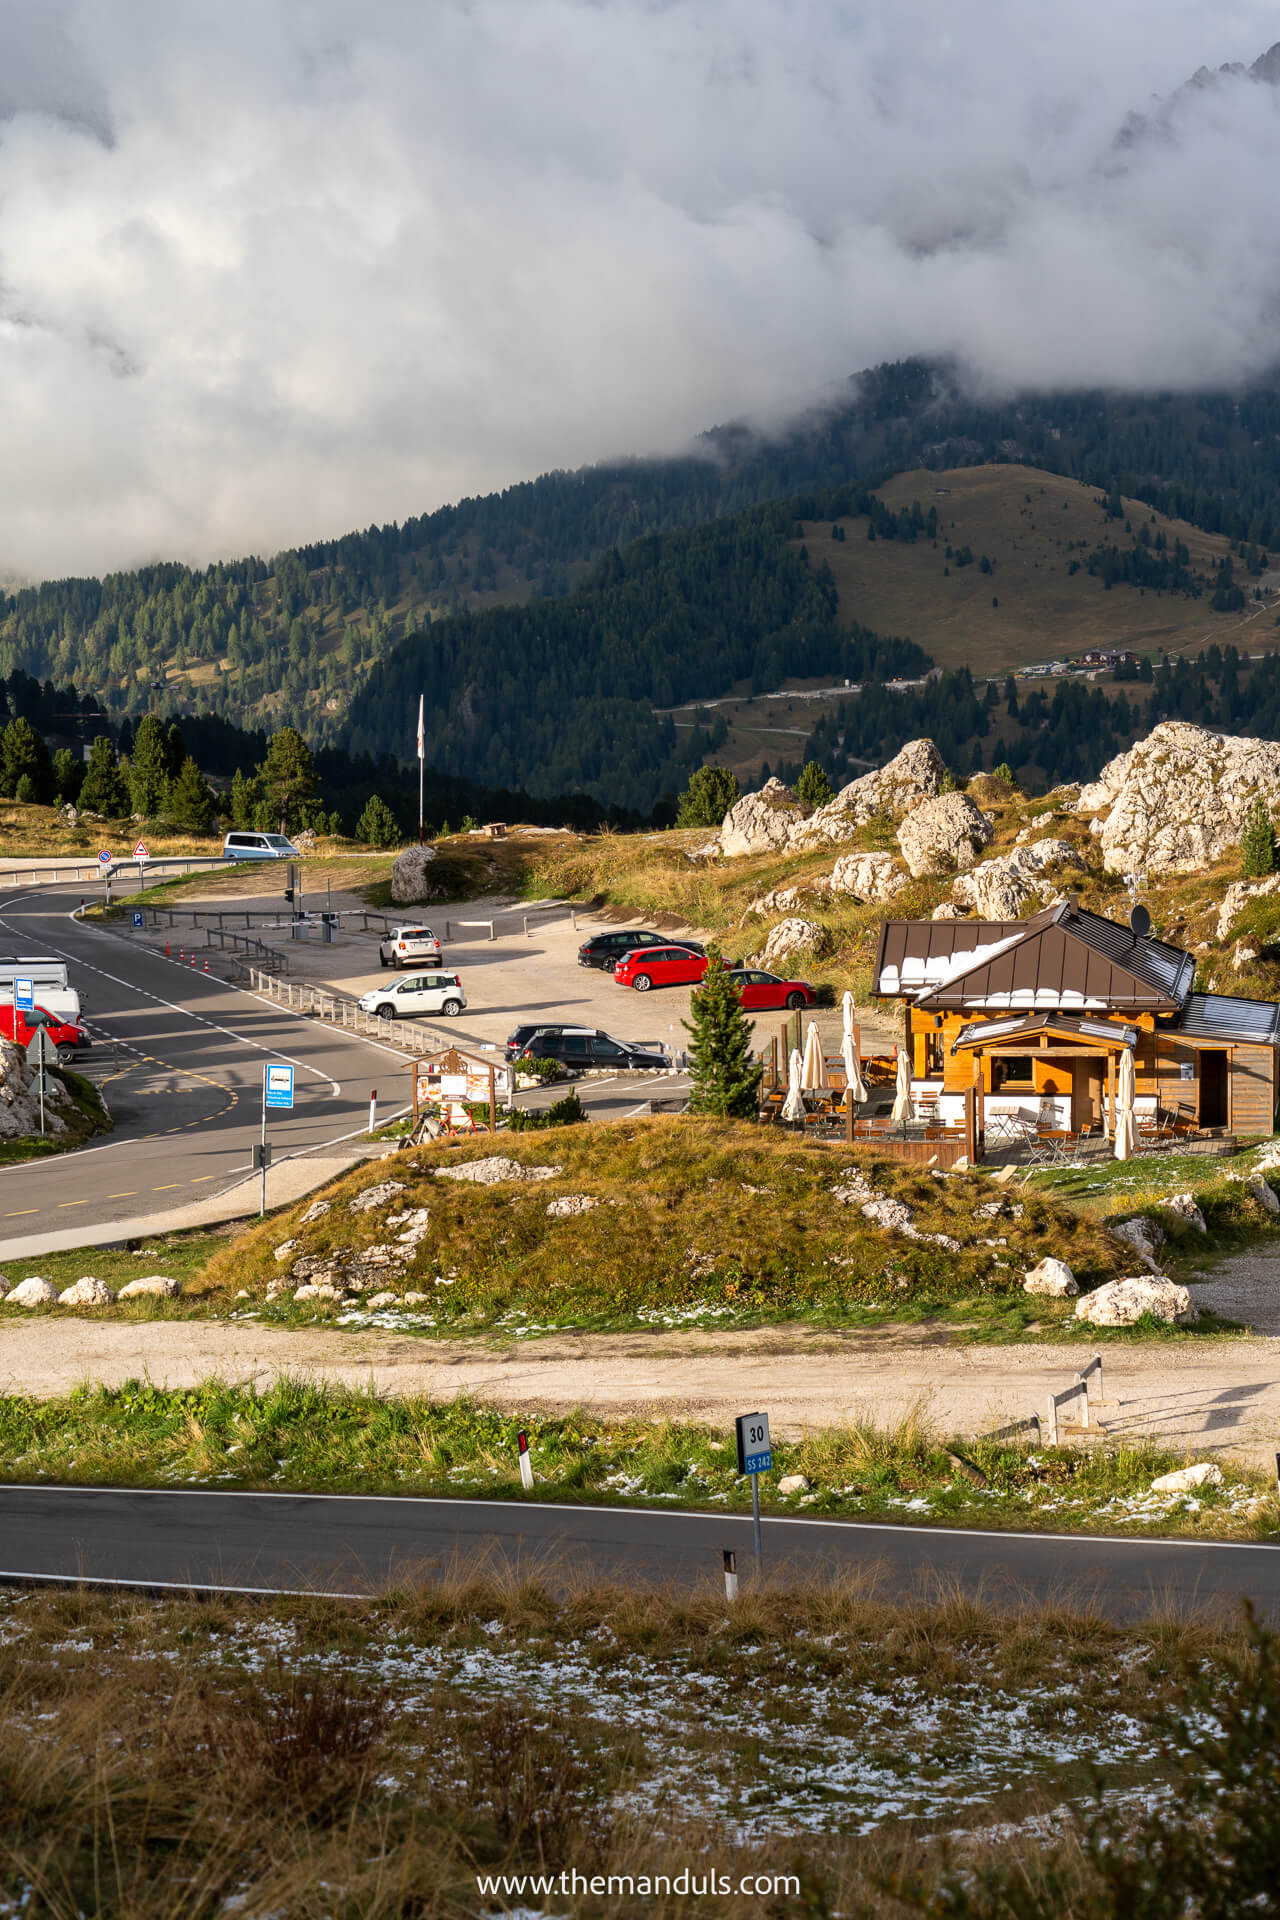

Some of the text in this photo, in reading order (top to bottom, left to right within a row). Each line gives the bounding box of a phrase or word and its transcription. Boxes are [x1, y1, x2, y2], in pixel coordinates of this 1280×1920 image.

[750, 1425, 764, 1444] 30
[747, 1456, 770, 1471] SS 242
